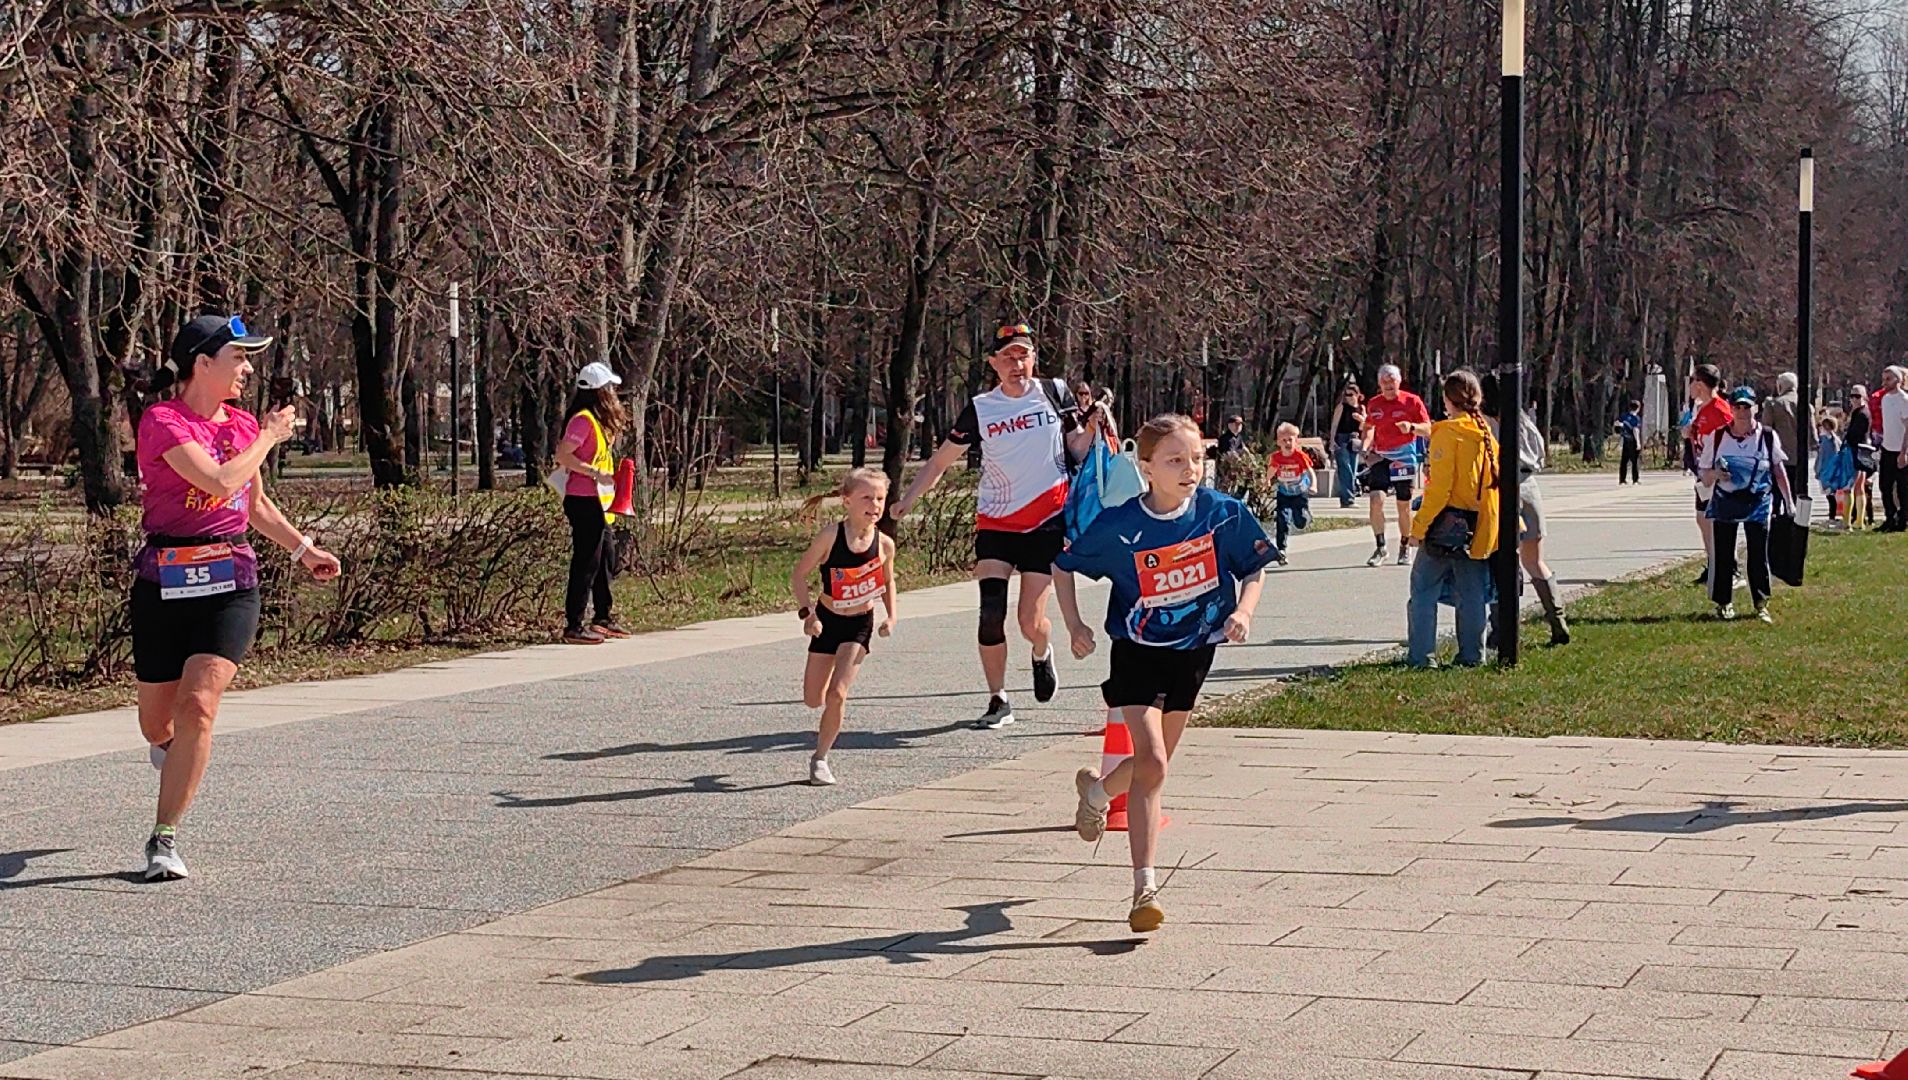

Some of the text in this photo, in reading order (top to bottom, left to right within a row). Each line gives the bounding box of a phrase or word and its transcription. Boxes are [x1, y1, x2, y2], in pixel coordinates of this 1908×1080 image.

[185, 566, 211, 585] 35
[1153, 562, 1206, 592] 2021
[841, 577, 876, 599] 2165
